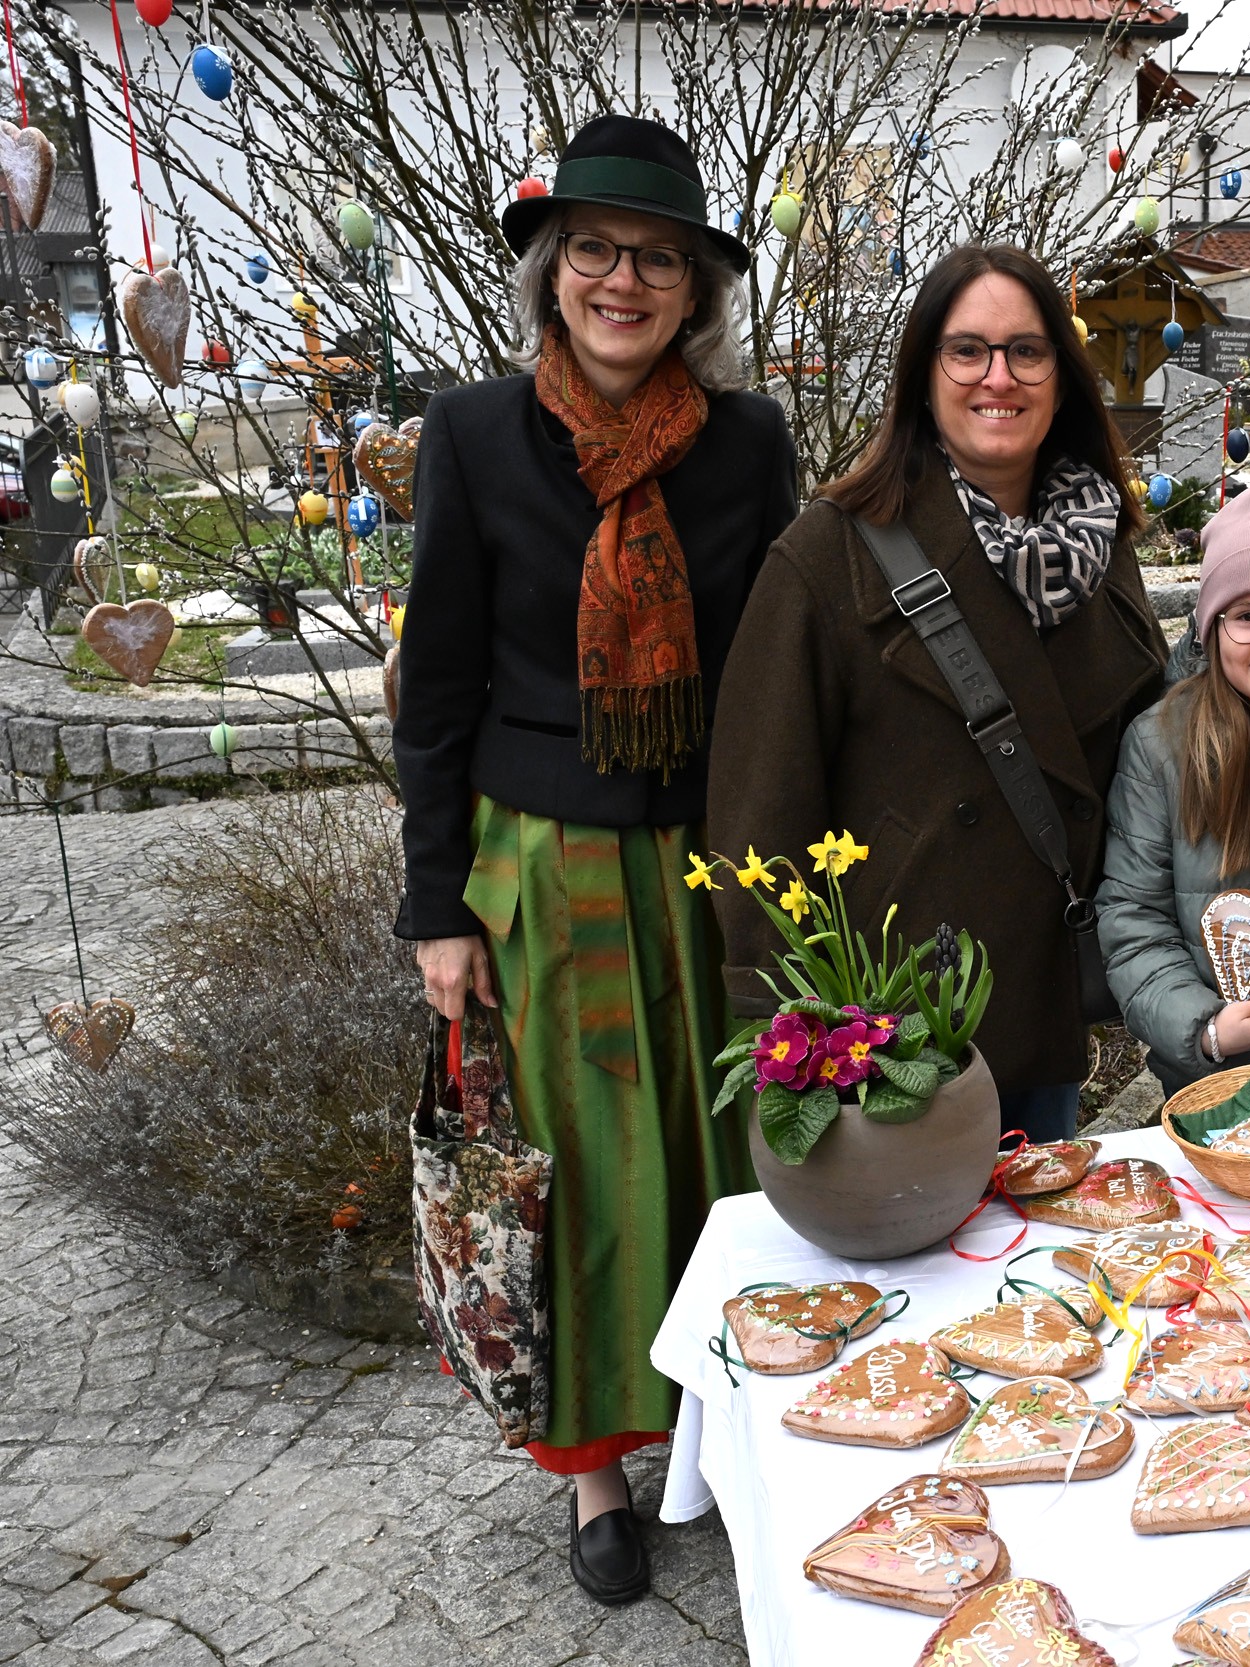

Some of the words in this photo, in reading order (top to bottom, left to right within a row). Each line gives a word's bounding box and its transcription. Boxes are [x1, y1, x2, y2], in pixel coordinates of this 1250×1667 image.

[1182, 341, 1202, 349] Fischer
[1021, 1304, 1045, 1339] Danke
[867, 1349, 911, 1400] Bussi
[895, 1532, 938, 1576] Du
